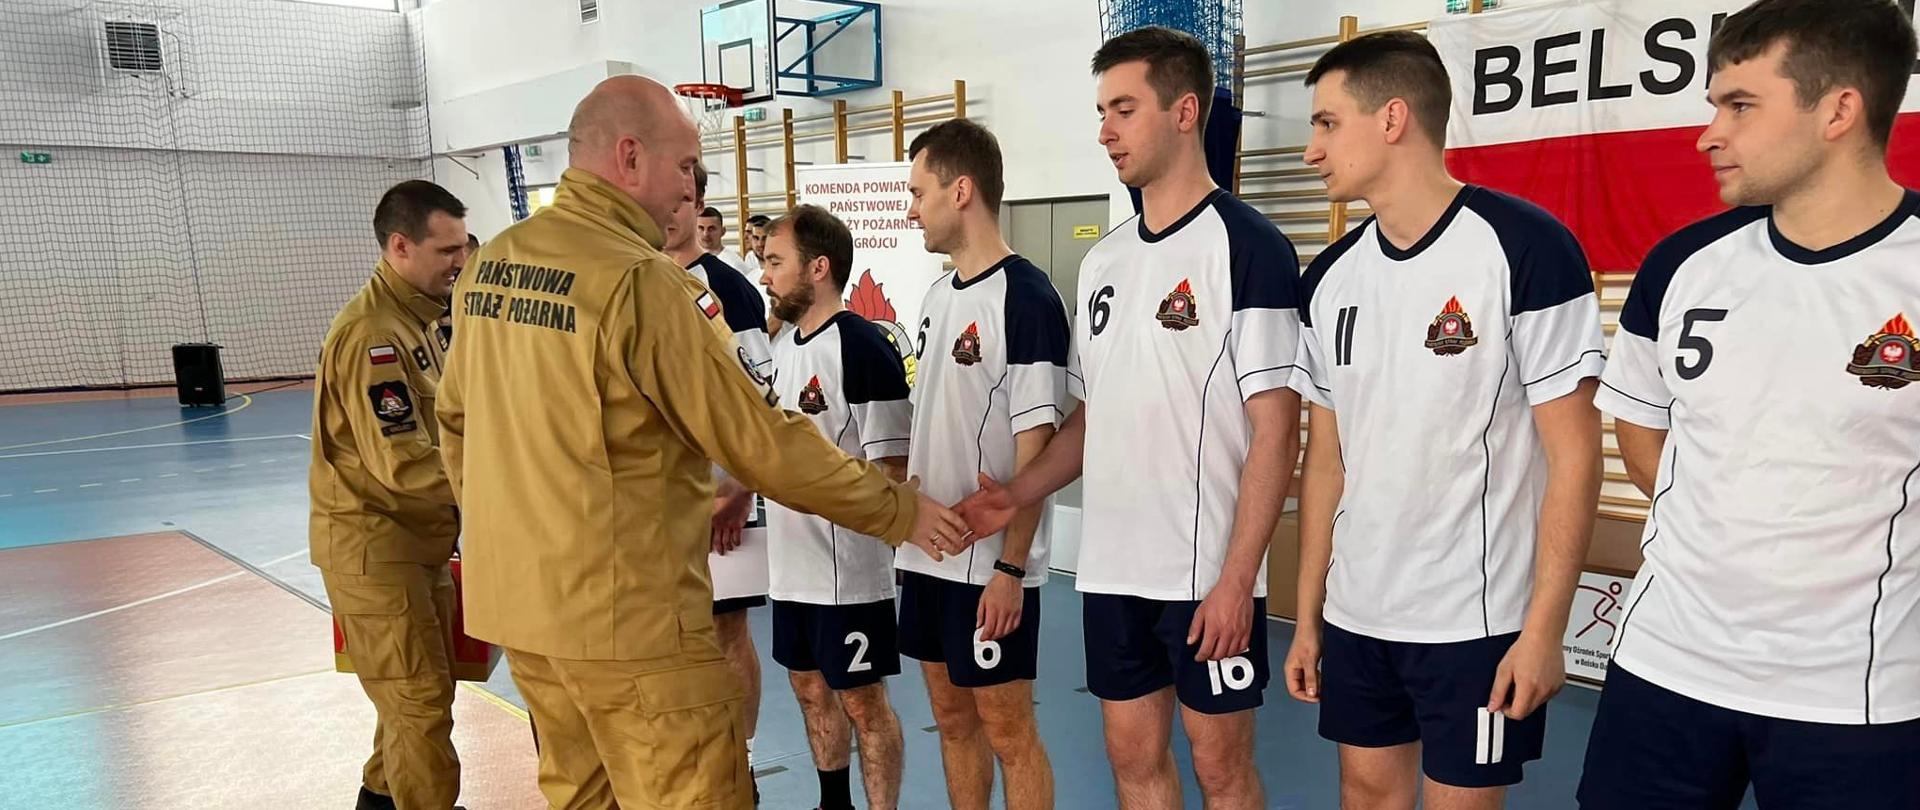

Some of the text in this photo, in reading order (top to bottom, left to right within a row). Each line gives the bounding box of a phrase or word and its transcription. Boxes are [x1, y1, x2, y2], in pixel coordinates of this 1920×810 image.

[805, 182, 860, 195] KOMENDA
[830, 199, 908, 212] PAŃSTWOWEJ
[854, 234, 898, 249] GRÓJCU
[475, 258, 577, 296] PAŃSTWOWA
[464, 291, 577, 333] STRAŻ POŻARNA
[916, 316, 931, 361] 6
[1335, 306, 1358, 366] 11
[1676, 308, 1729, 380] 5
[844, 631, 872, 672] 2
[973, 627, 1001, 669] 6
[1207, 651, 1255, 696] 16
[1476, 707, 1504, 764] 11
